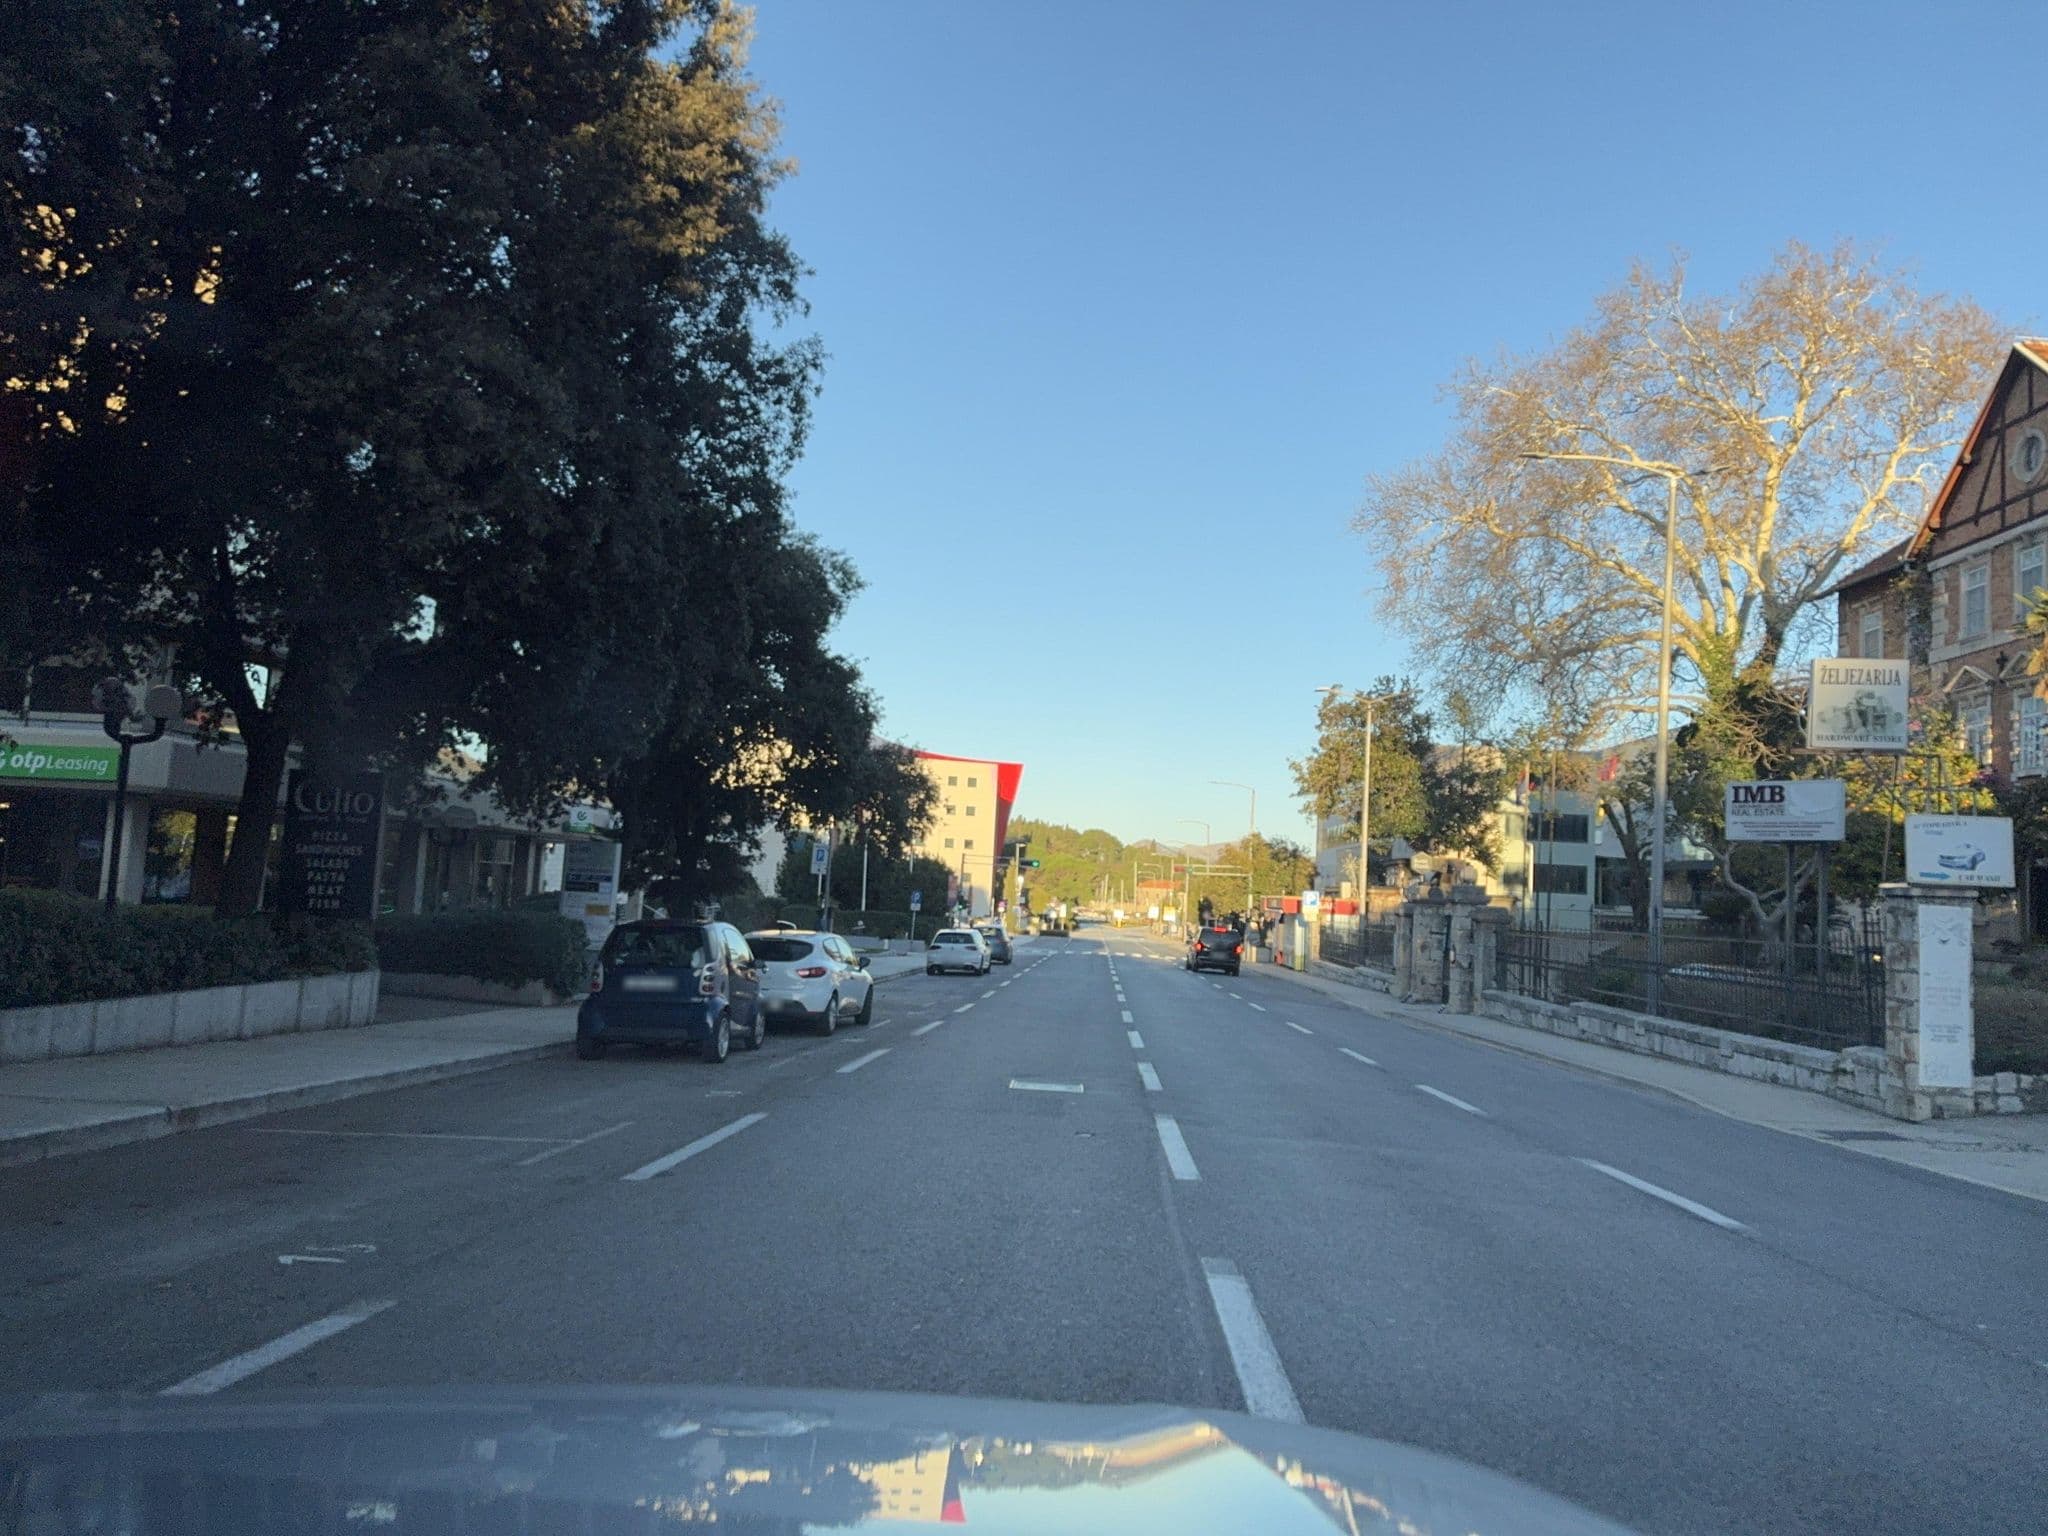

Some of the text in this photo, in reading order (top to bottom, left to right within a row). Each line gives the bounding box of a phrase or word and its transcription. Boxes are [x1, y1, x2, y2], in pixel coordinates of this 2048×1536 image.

[1820, 665, 1902, 686] ŽELJEZARIJA
[1816, 734, 1904, 744] HARDWARE STORE
[10, 751, 109, 776] otp Leasing
[1731, 784, 1786, 804] IMB
[1731, 807, 1785, 816] REAL ESTATE
